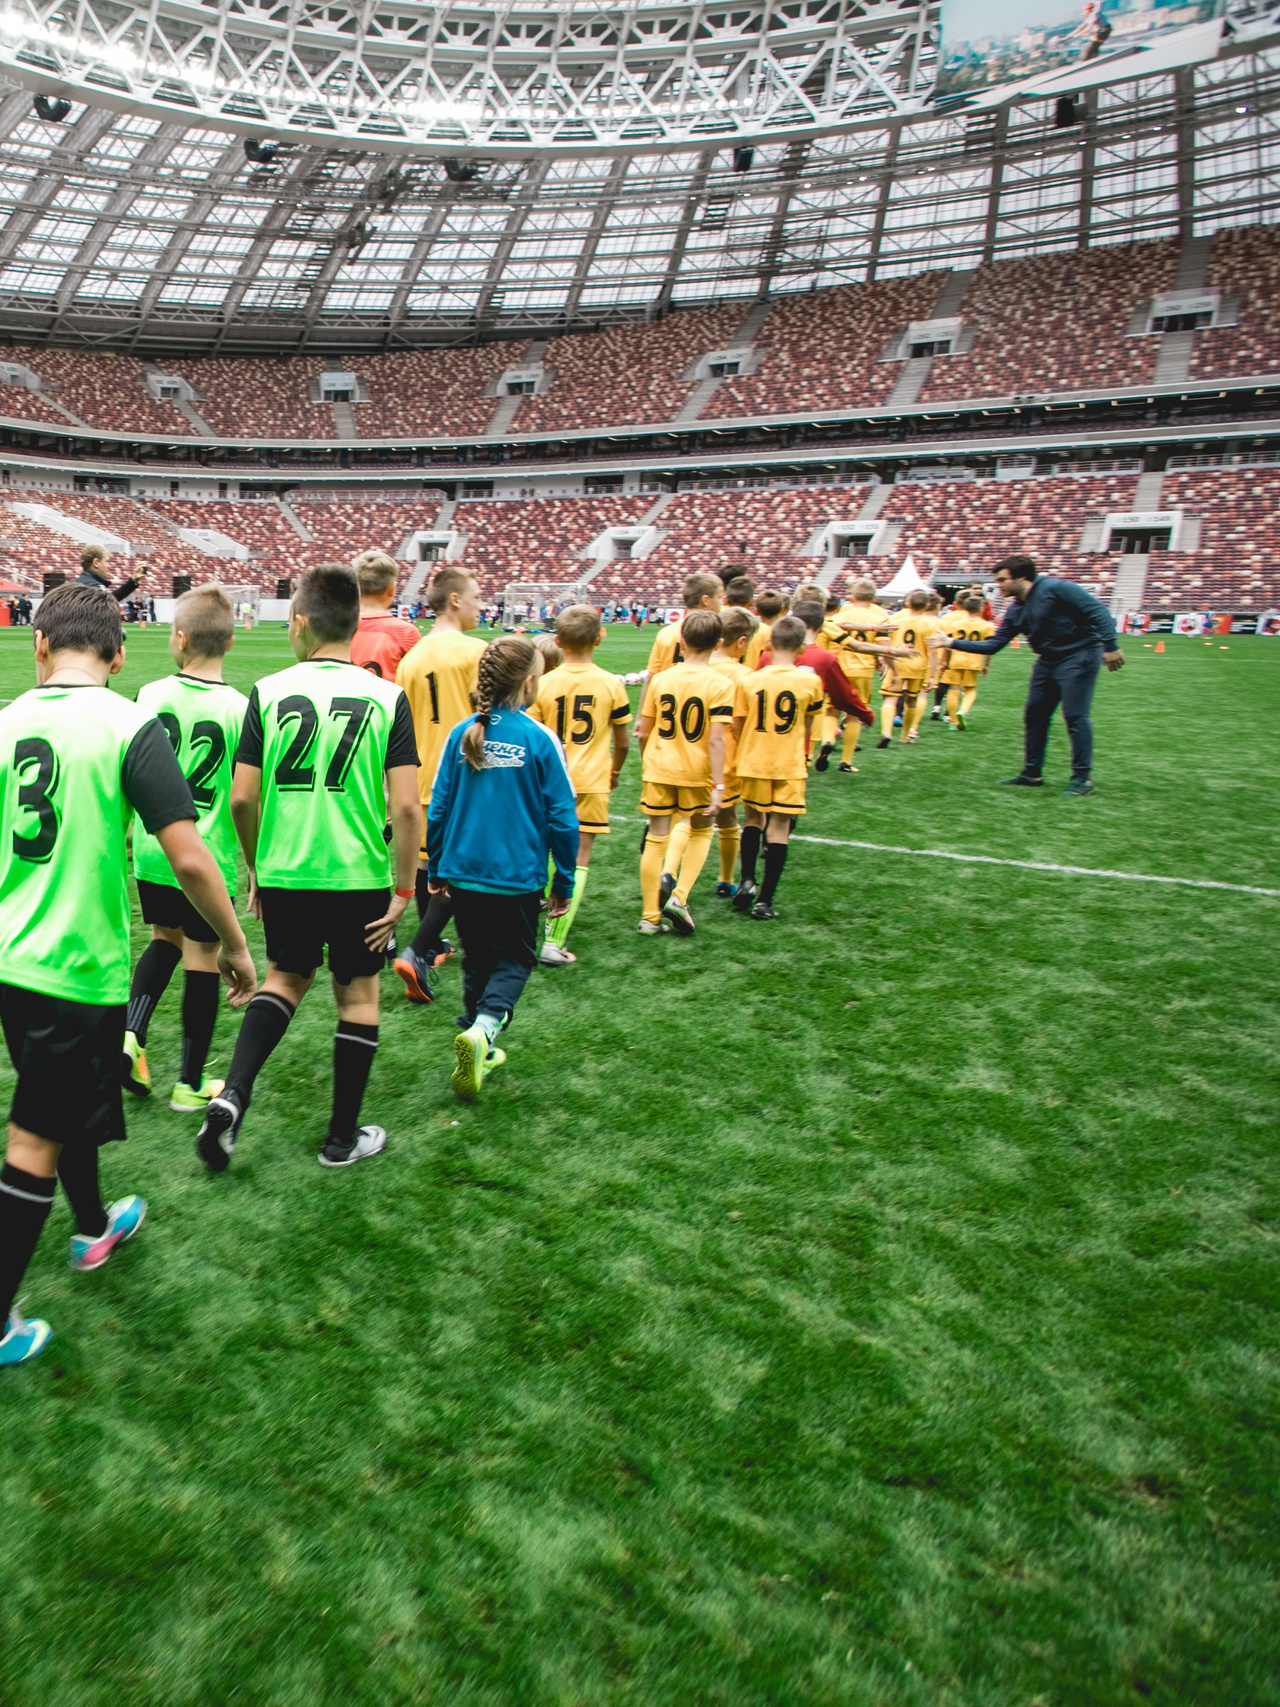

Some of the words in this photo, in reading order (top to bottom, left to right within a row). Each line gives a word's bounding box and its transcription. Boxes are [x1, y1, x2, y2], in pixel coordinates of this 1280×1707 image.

[425, 670, 440, 724] 1
[555, 694, 595, 744] 15
[658, 693, 706, 743] 30
[755, 689, 798, 735] 19
[275, 695, 374, 792] 27
[12, 737, 62, 864] 3
